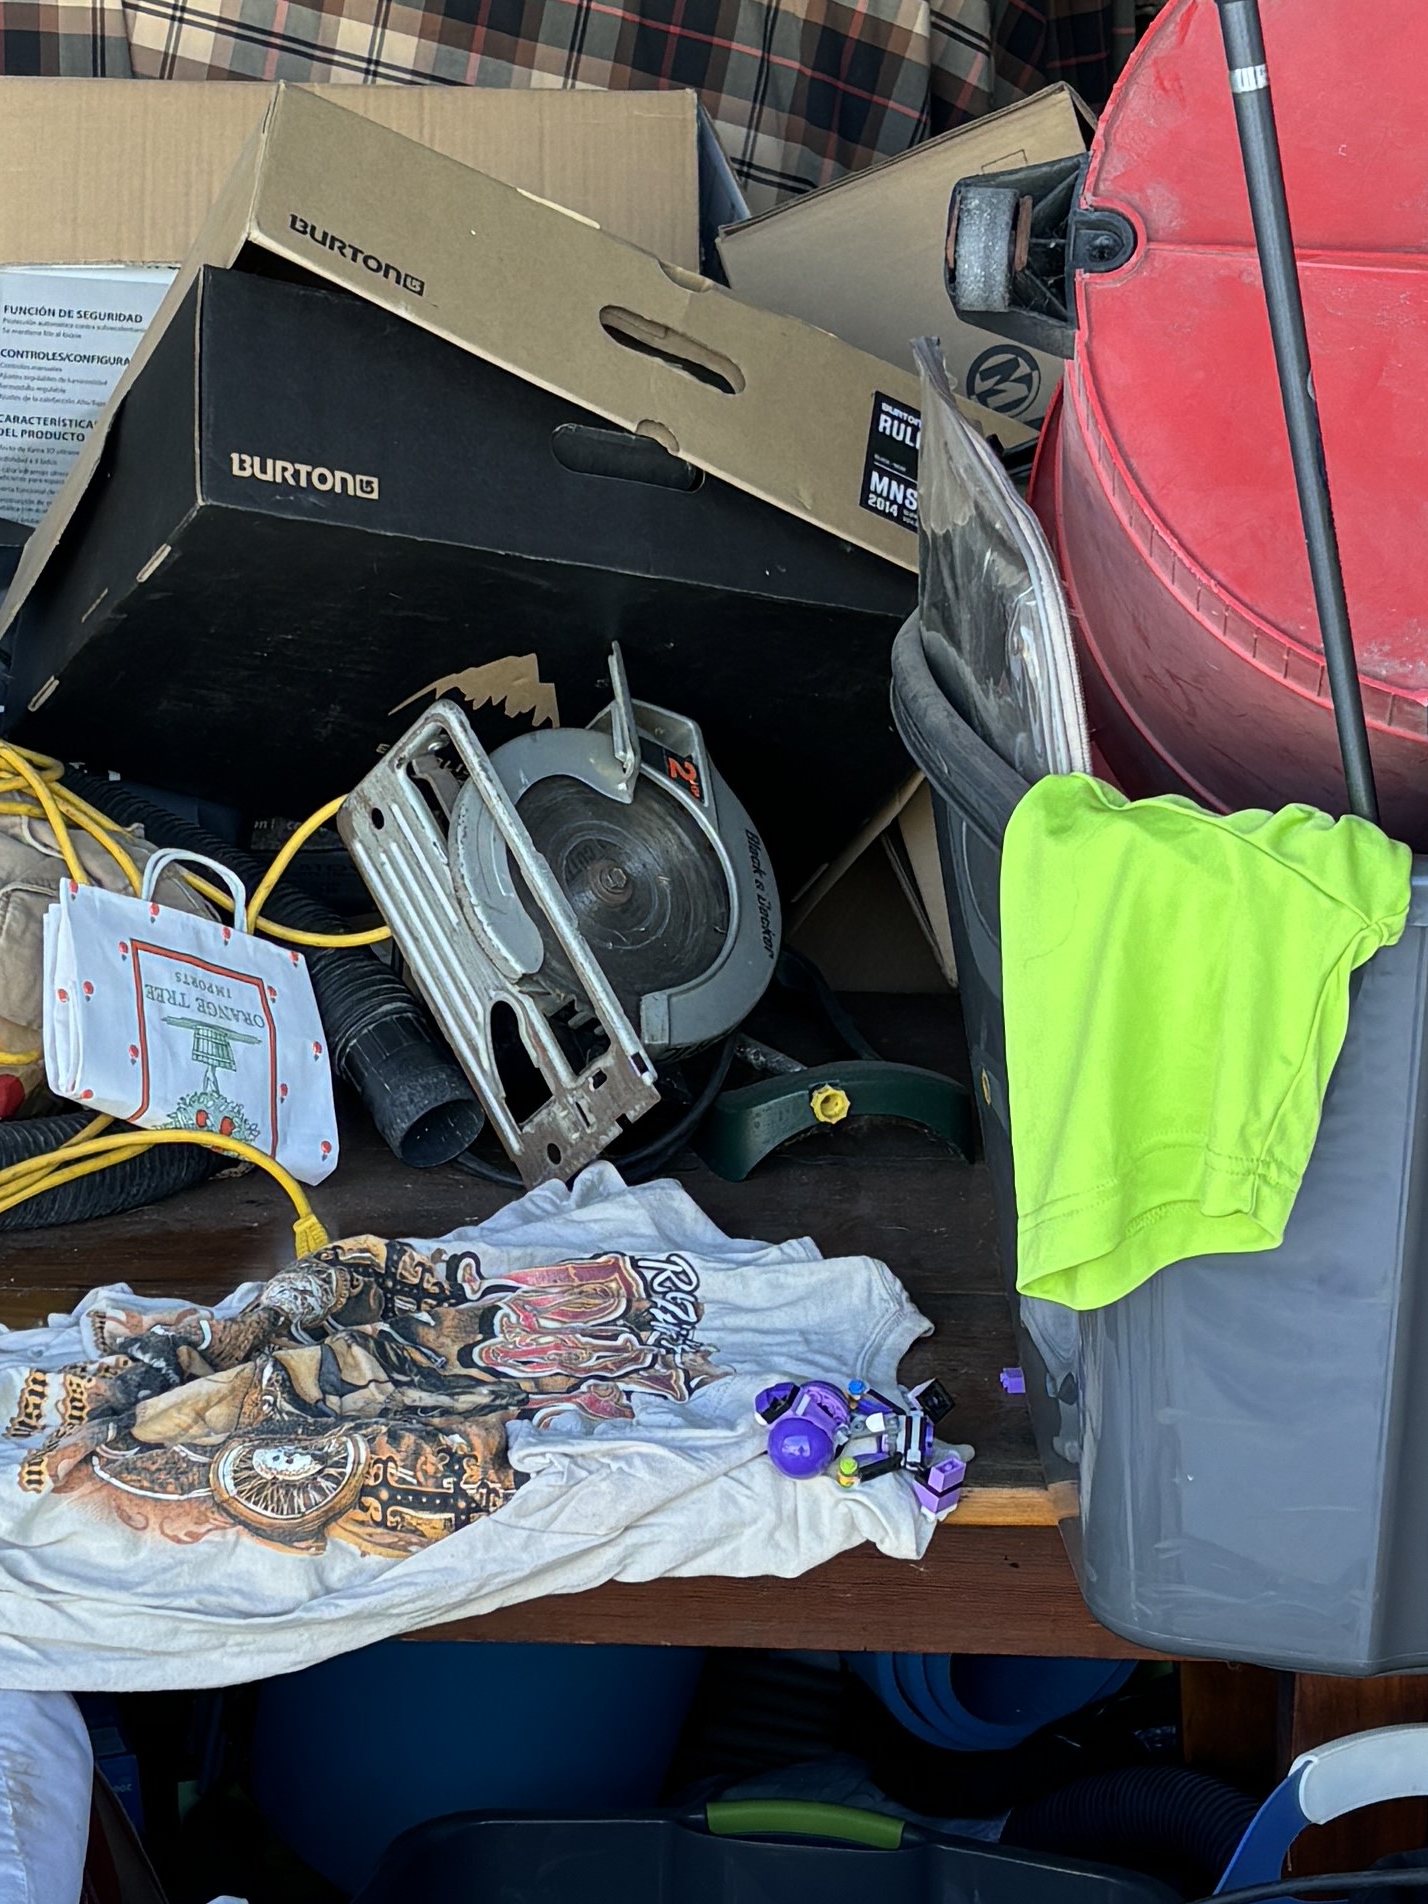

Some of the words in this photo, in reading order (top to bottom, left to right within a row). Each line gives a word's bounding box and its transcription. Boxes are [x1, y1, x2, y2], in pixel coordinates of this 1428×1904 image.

[289, 213, 403, 287] BURTON
[4, 304, 55, 318] FUNCIÓN
[59, 308, 74, 319] DE
[76, 310, 143, 324] SEGURIDAD
[21, 430, 85, 442] PRODUCTO
[879, 414, 921, 450] RUL
[230, 452, 355, 497] BURTON
[868, 493, 899, 517] 2014
[667, 757, 697, 782] 2
[745, 829, 767, 879] Black
[757, 894, 776, 960] Decker
[144, 983, 190, 1009] TREE
[174, 972, 232, 999] IMPORTS
[194, 997, 265, 1029] ORANGE
